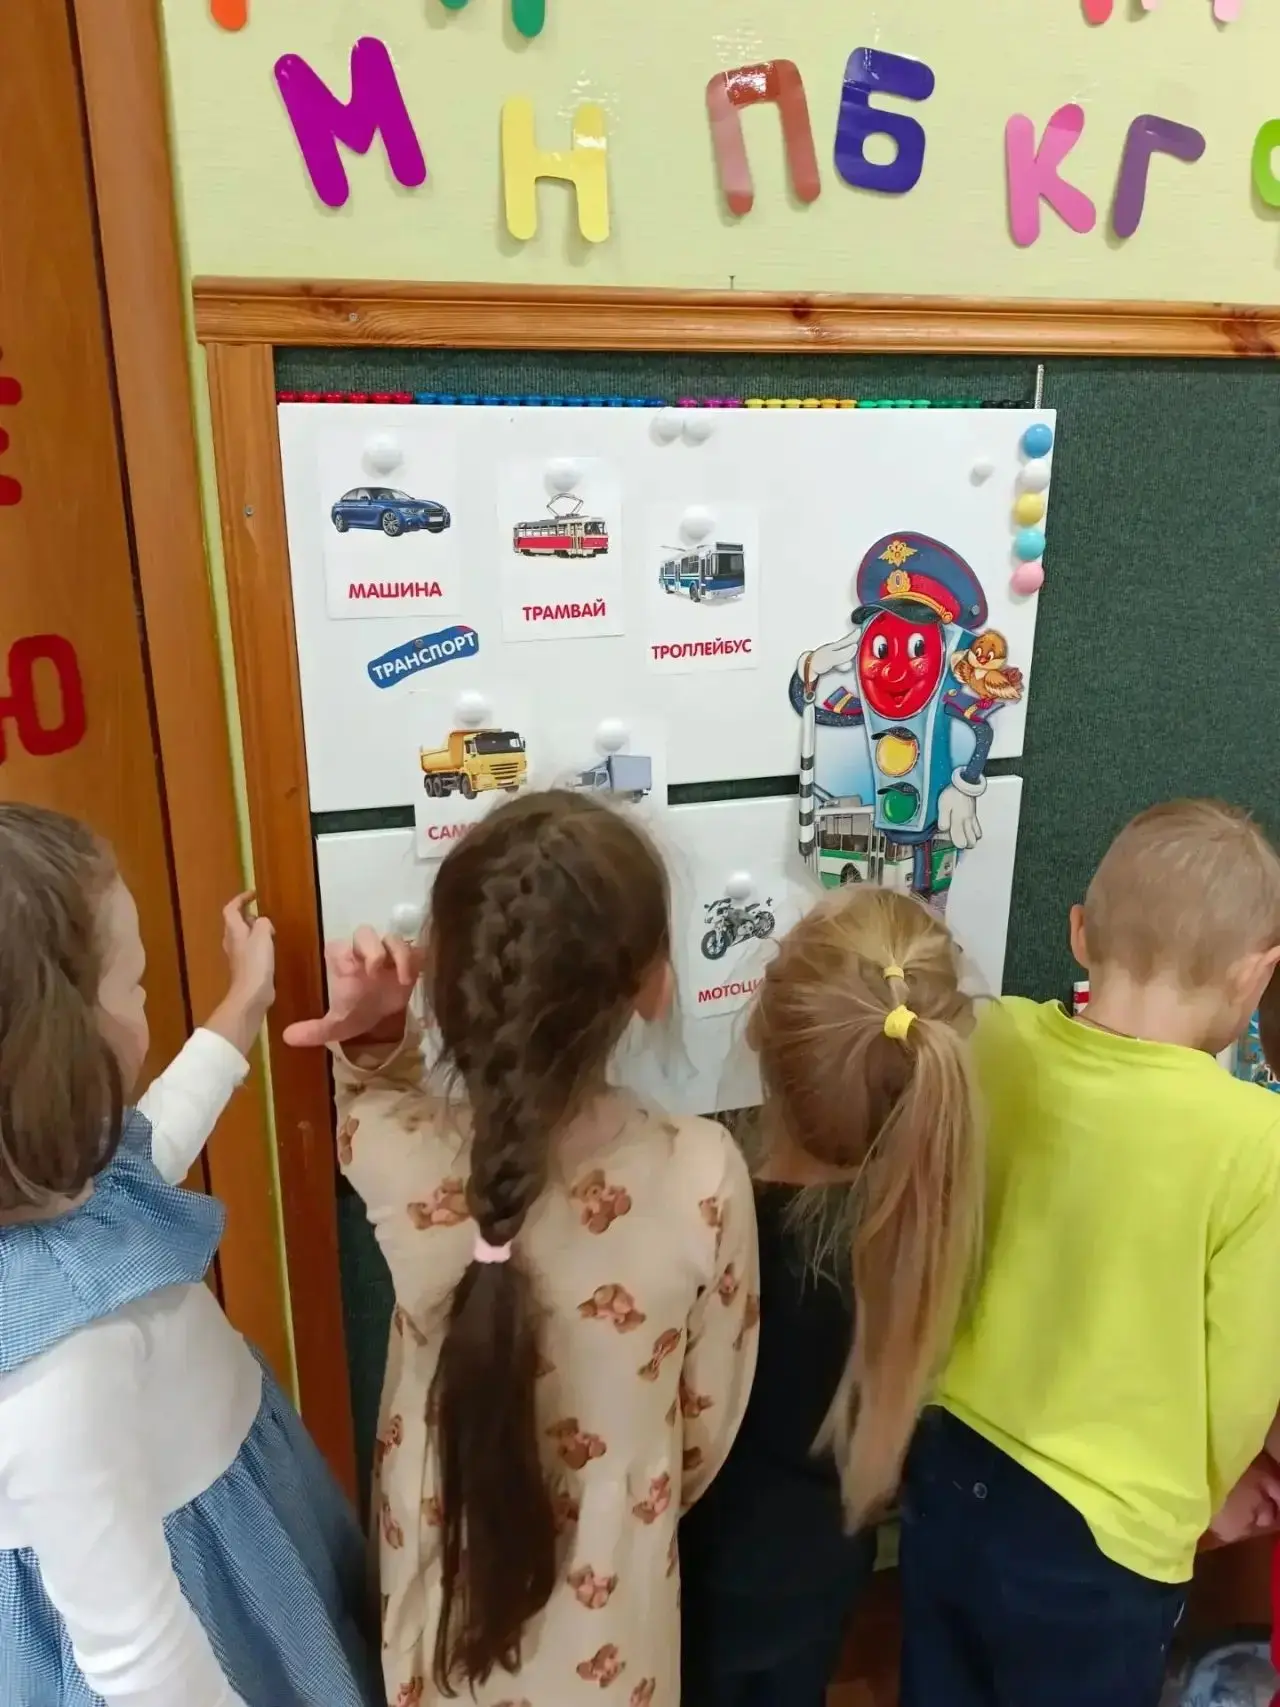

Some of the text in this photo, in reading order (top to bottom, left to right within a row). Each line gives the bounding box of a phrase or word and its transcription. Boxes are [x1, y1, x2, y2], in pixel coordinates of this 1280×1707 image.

[274, 36, 426, 207] М
[502, 96, 610, 243] Н
[348, 581, 442, 599] МАШИНА
[523, 599, 606, 620] ТРАМВАЙ
[372, 631, 476, 681] ТРАНСПОРТ
[652, 637, 751, 660] ТРОЛЛЕЙБУС
